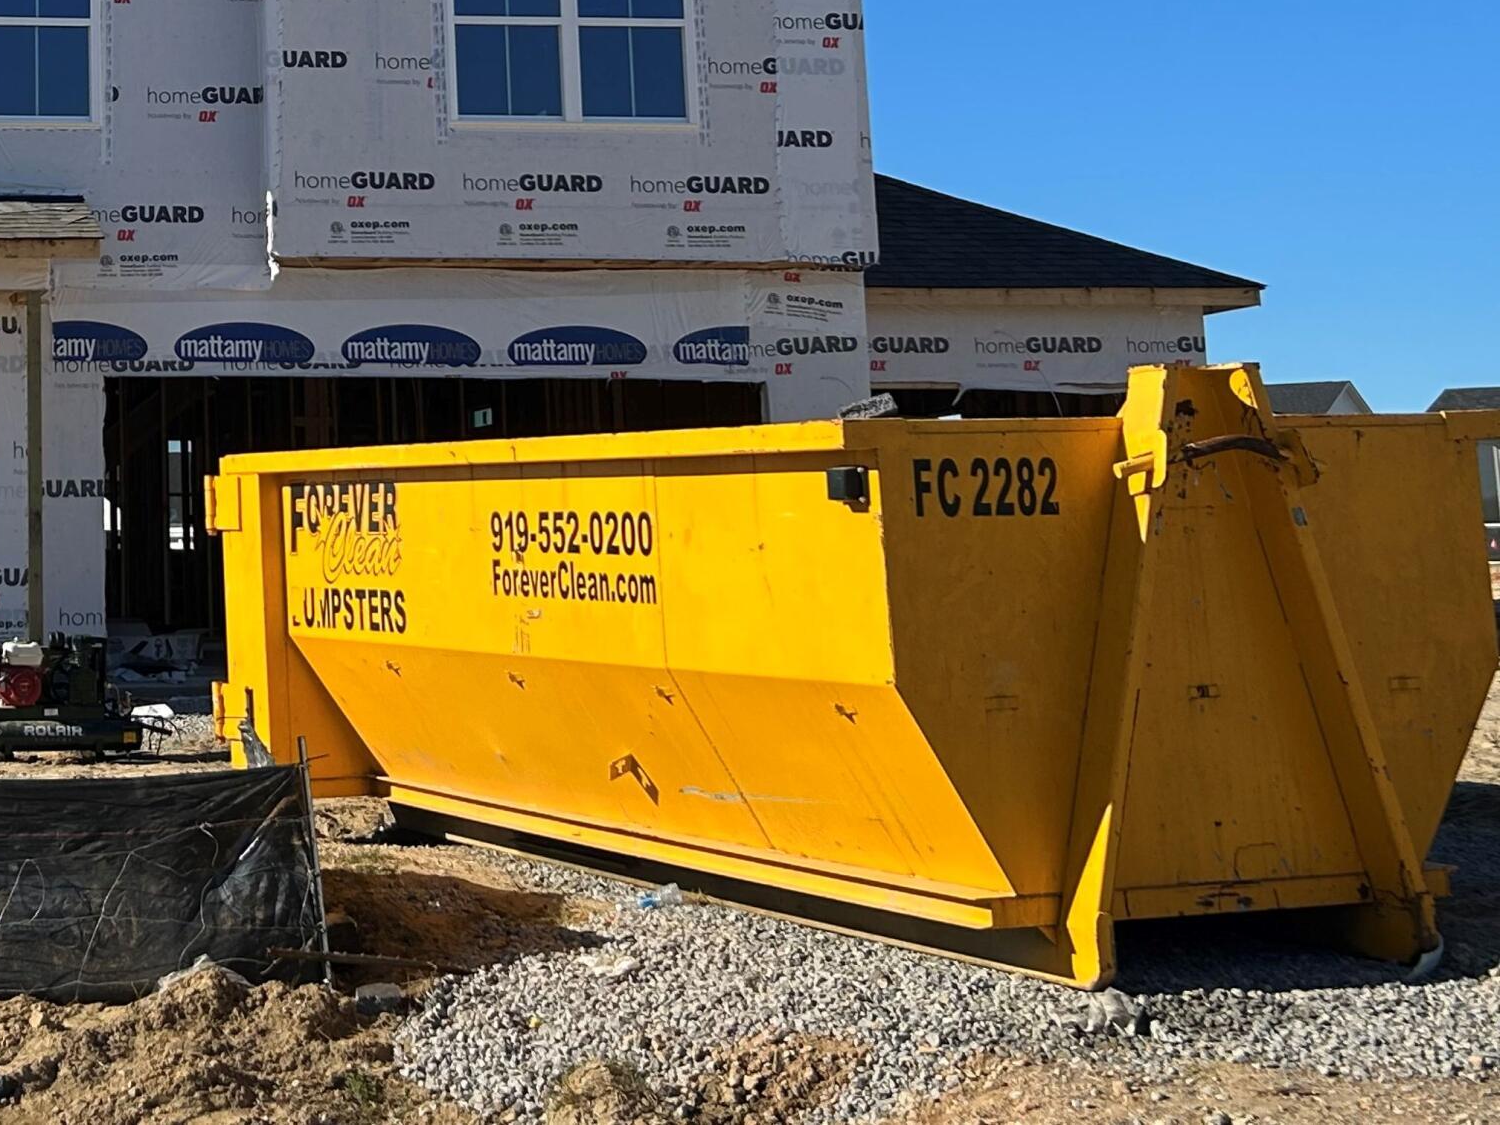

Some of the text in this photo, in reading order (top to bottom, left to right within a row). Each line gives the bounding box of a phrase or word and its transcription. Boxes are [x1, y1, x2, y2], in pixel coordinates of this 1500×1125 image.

[822, 37, 840, 49] OX
[760, 82, 777, 93] OX
[199, 111, 217, 122] OX
[294, 171, 434, 190] homeGUARD
[463, 172, 602, 192] homeGUARD
[630, 175, 769, 194] homeGUARD
[347, 196, 366, 208] OX
[515, 199, 533, 210] OX
[683, 200, 701, 212] OX
[350, 220, 409, 229] oxep.com
[519, 222, 578, 232] oxep.com
[687, 224, 745, 233] oxep.com
[117, 229, 134, 241] OX
[120, 253, 178, 263] oxep.com
[784, 272, 800, 283] OX
[786, 293, 843, 309] oxep.com
[180, 338, 263, 363] mattamy
[347, 339, 429, 363] mattamy
[974, 337, 1102, 355] homeGUARD
[513, 340, 595, 365] mattamy
[775, 363, 792, 375] OX
[1023, 360, 1040, 371] OX
[913, 457, 1060, 516] FC 2282
[491, 510, 653, 557] 919-552-0200
[322, 509, 400, 584] Clean
[493, 558, 657, 605] ForeverClean.com
[24, 724, 82, 738] ROLAIR
